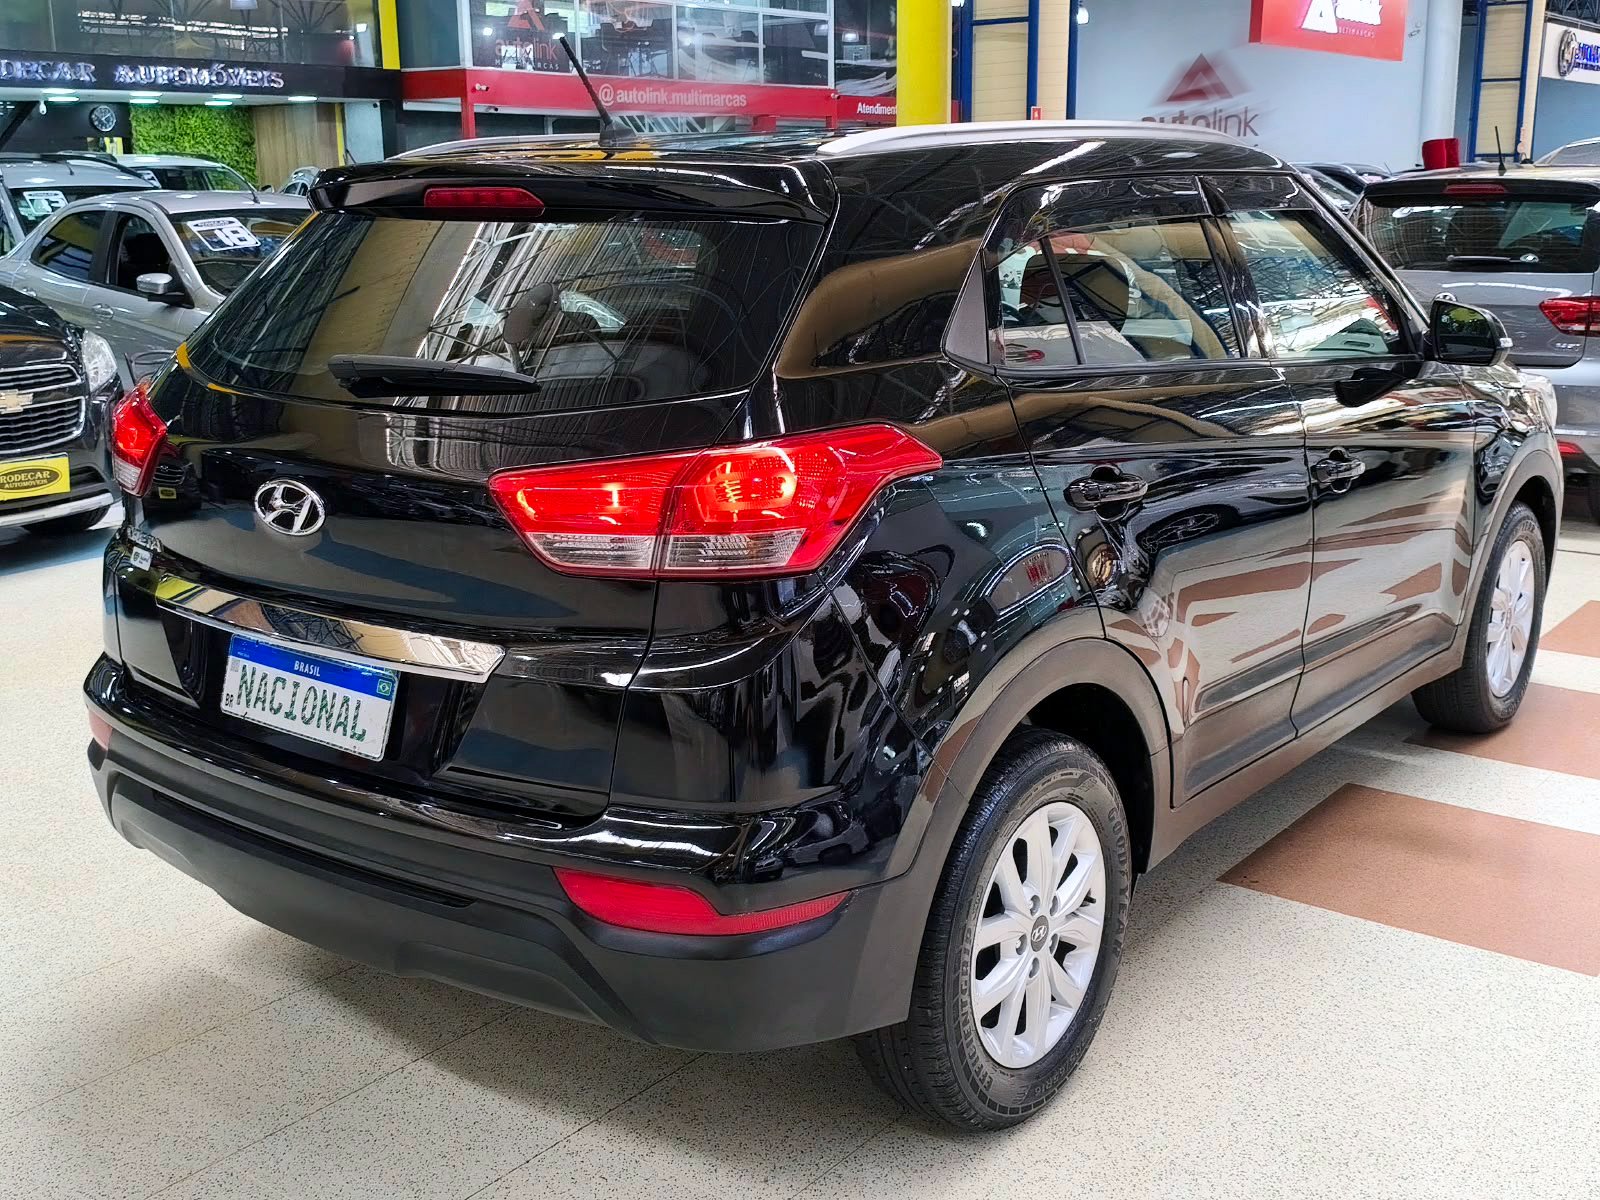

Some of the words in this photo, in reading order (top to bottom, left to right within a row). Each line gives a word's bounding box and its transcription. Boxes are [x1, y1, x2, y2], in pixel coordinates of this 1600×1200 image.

[114, 62, 285, 89] AUTOMÓVEIS
[294, 660, 321, 677] BRASIL
[225, 693, 234, 708] BR
[236, 664, 367, 742] NACIONAL
[1107, 806, 1129, 958] GOODYEAR
